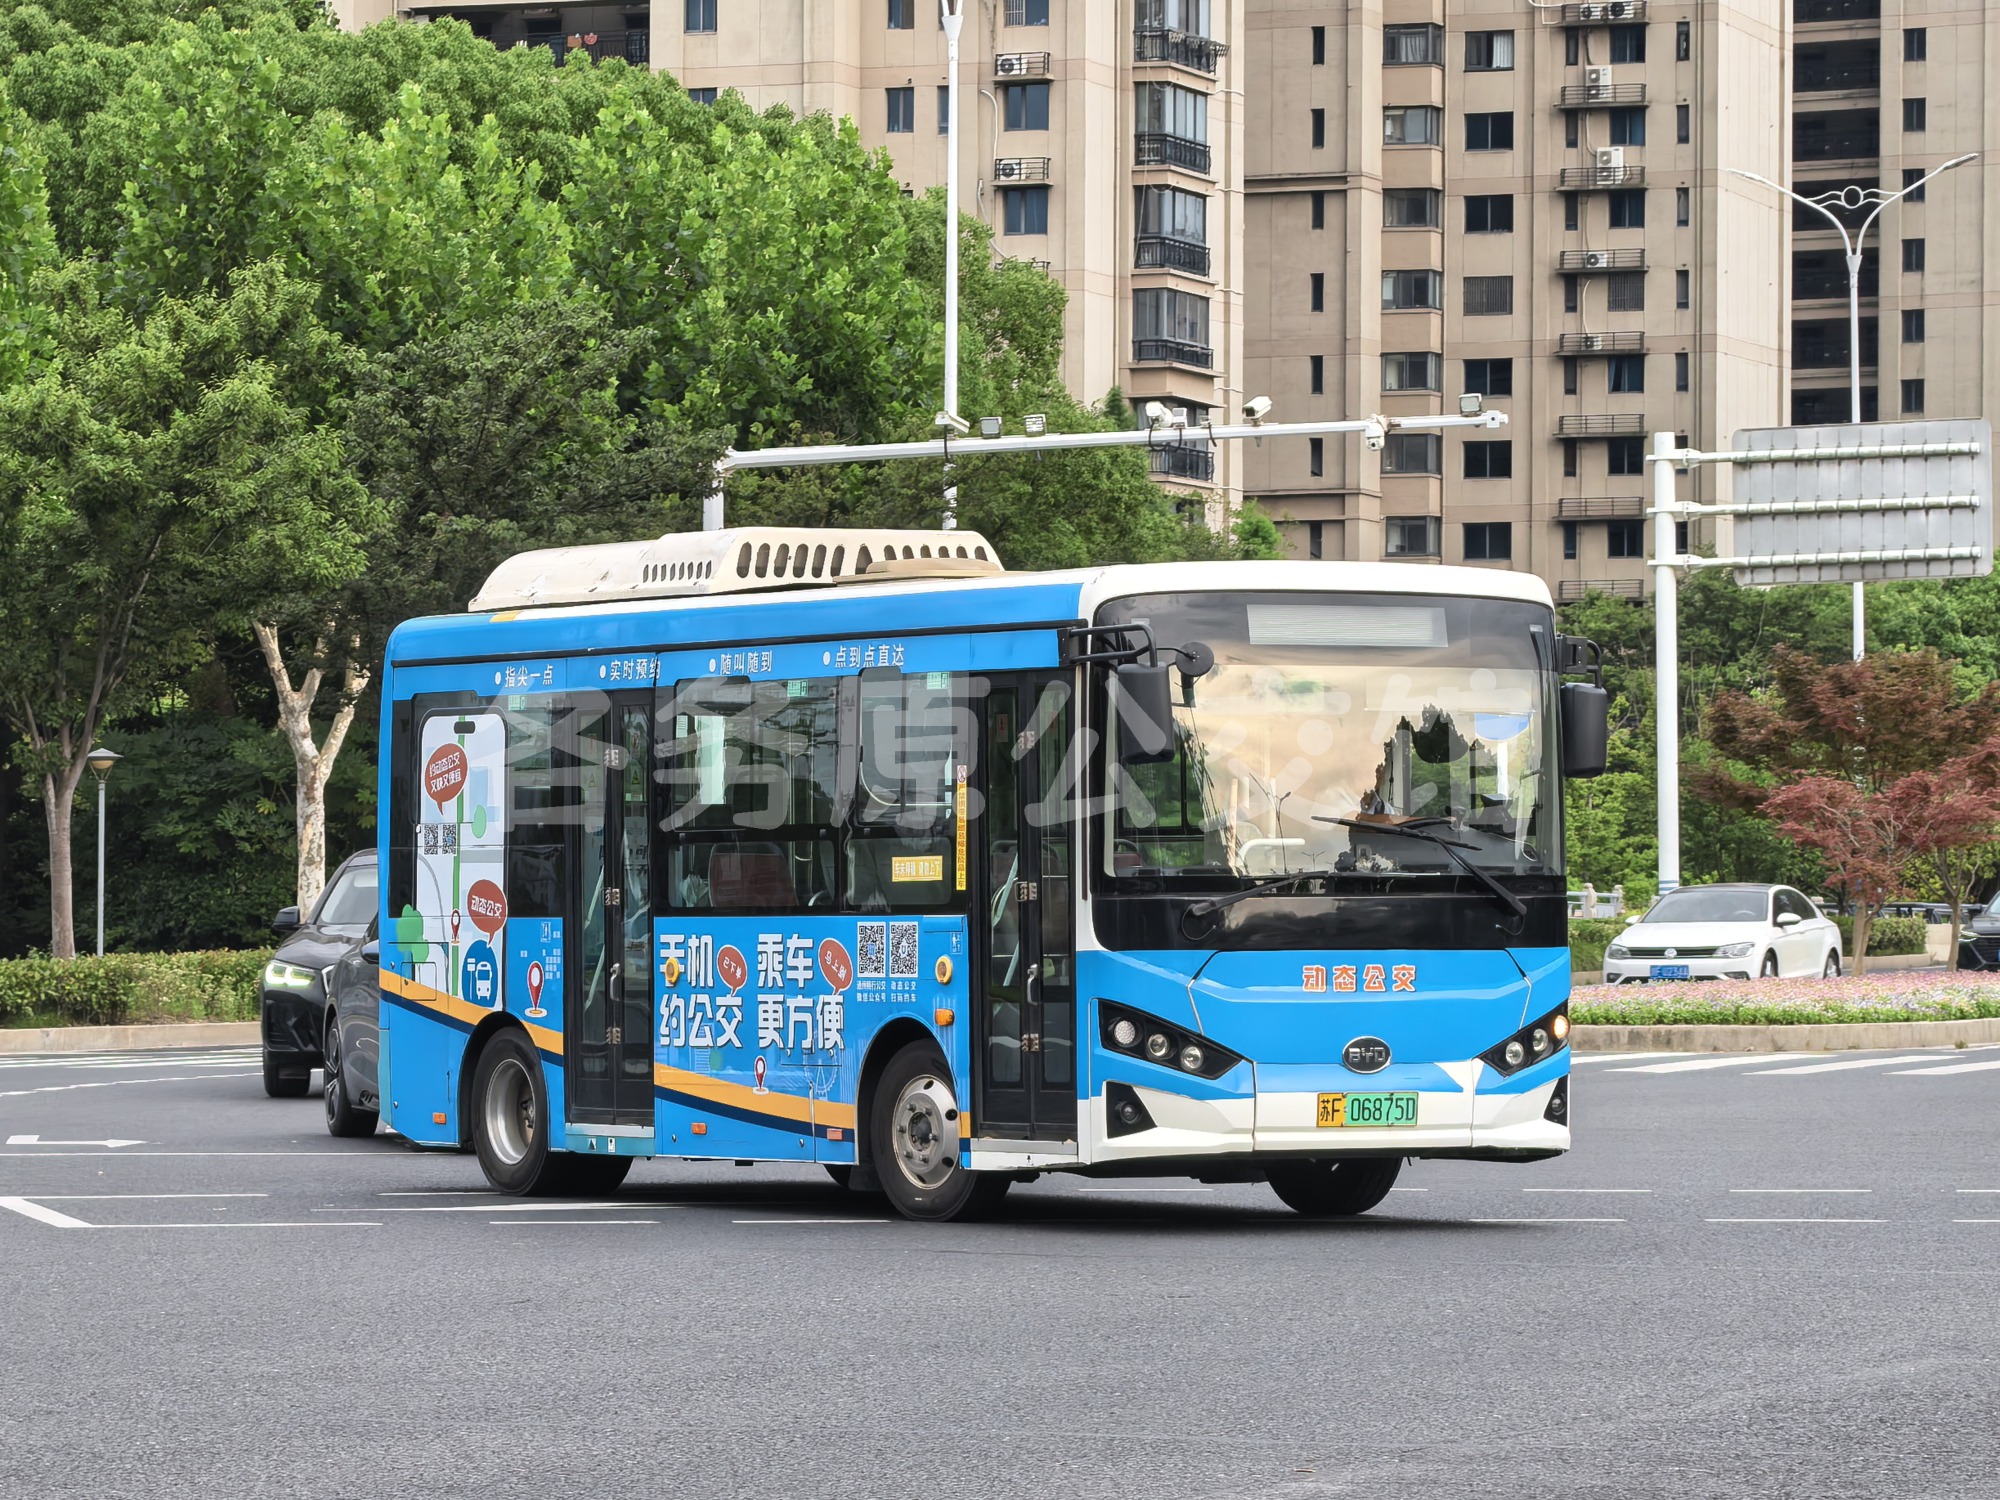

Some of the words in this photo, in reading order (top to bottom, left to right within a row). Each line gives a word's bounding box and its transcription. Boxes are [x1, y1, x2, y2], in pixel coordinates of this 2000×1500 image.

[720, 650, 773, 676] 随叫随到
[835, 643, 905, 668] 点到点直达
[505, 664, 554, 688] 指尖一点
[610, 658, 661, 682] 实时预约
[471, 895, 503, 919] 动态公交
[659, 934, 714, 987] 手机
[757, 933, 814, 988] 乘车
[1302, 964, 1417, 993] 动态公交
[659, 994, 744, 1048] 约公交
[757, 994, 846, 1049] 更方便
[1348, 1046, 1386, 1063] BYD
